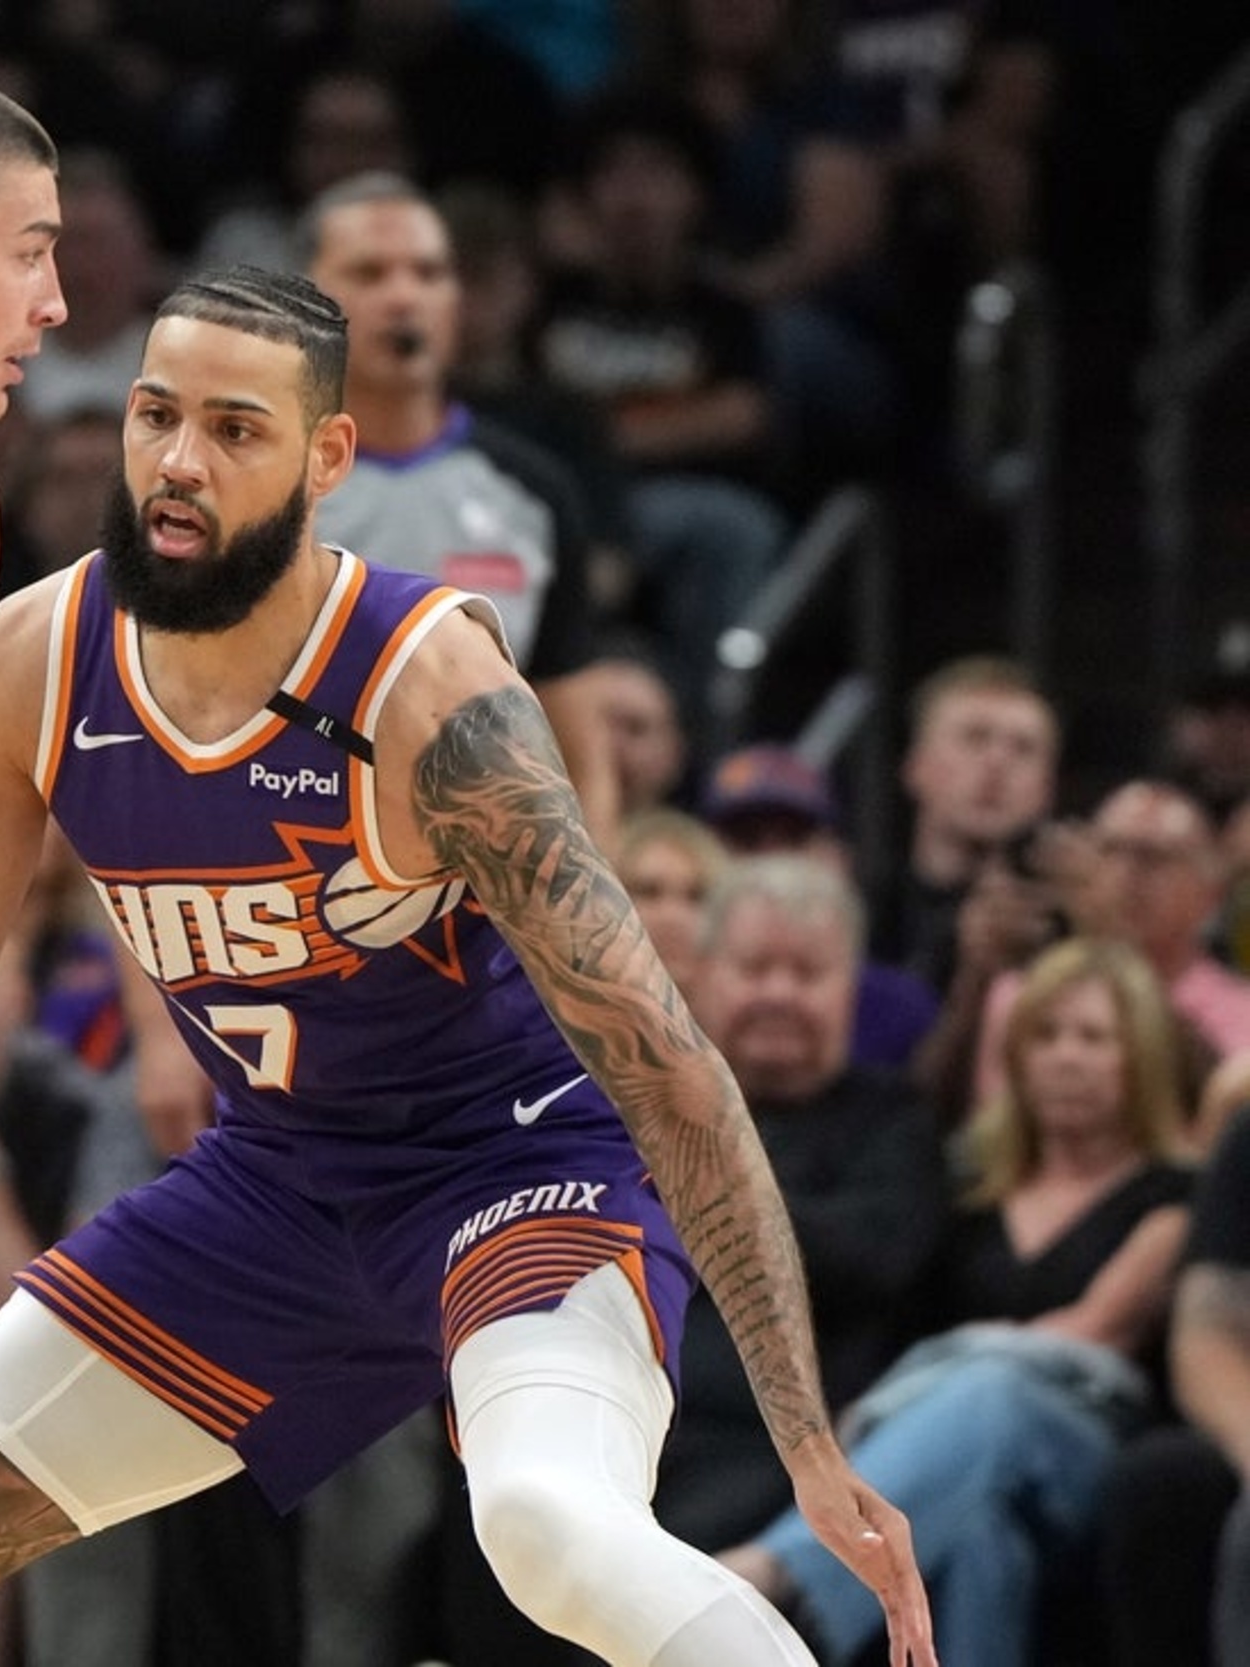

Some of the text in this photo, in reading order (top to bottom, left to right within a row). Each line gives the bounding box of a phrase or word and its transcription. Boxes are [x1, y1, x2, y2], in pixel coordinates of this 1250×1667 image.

[314, 716, 334, 738] AL
[250, 762, 339, 799] PayPal
[88, 874, 310, 983] UNS
[203, 1003, 297, 1094] 7
[445, 1181, 607, 1275] PHOENIX
